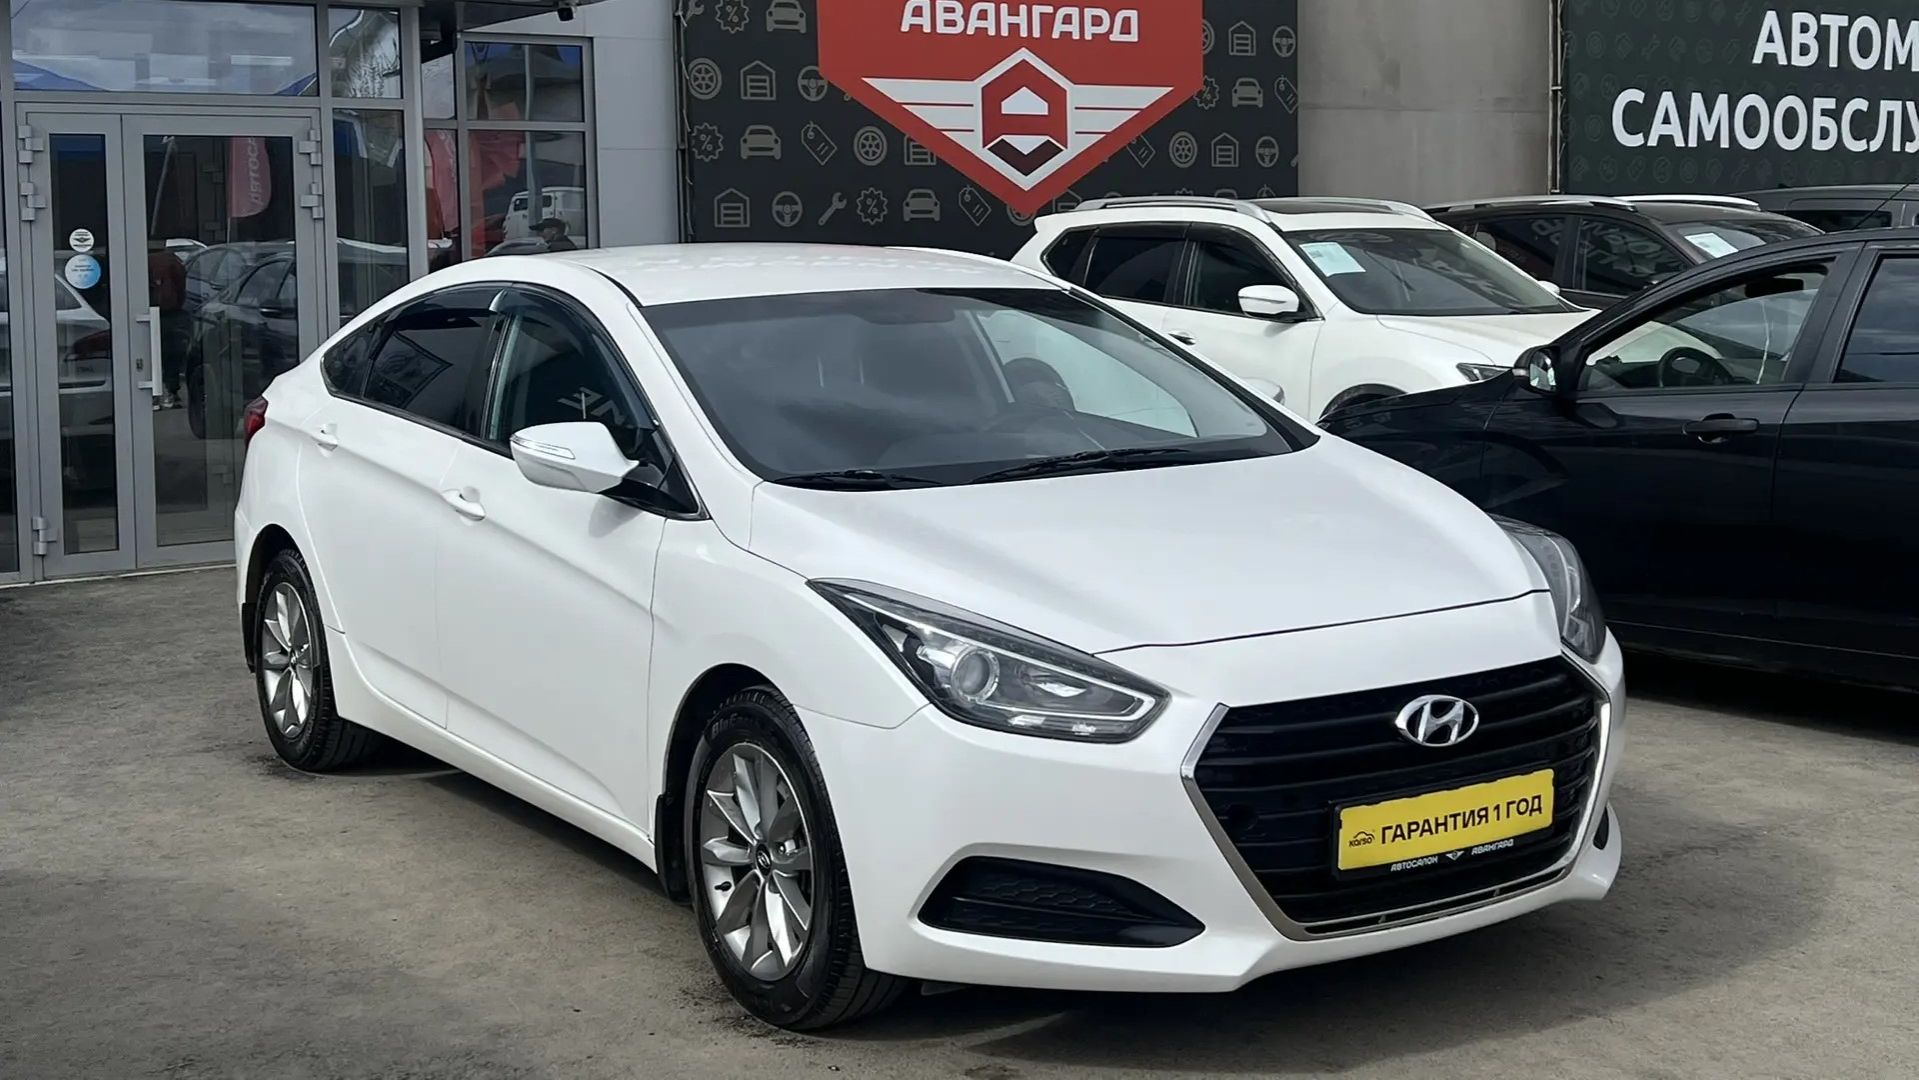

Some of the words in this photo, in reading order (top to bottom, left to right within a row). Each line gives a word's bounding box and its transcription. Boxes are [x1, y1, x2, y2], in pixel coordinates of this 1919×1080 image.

[899, 0, 1139, 43] АВАНГАРД
[1751, 9, 1919, 73] АВТОМ
[1380, 806, 1489, 845] ГАРАНТИЯ
[1492, 803, 1501, 822] 1
[1505, 794, 1543, 819] ГОД
[1390, 855, 1439, 872] АВТОСАЛОН
[1471, 838, 1514, 856] АВАНГАРД
